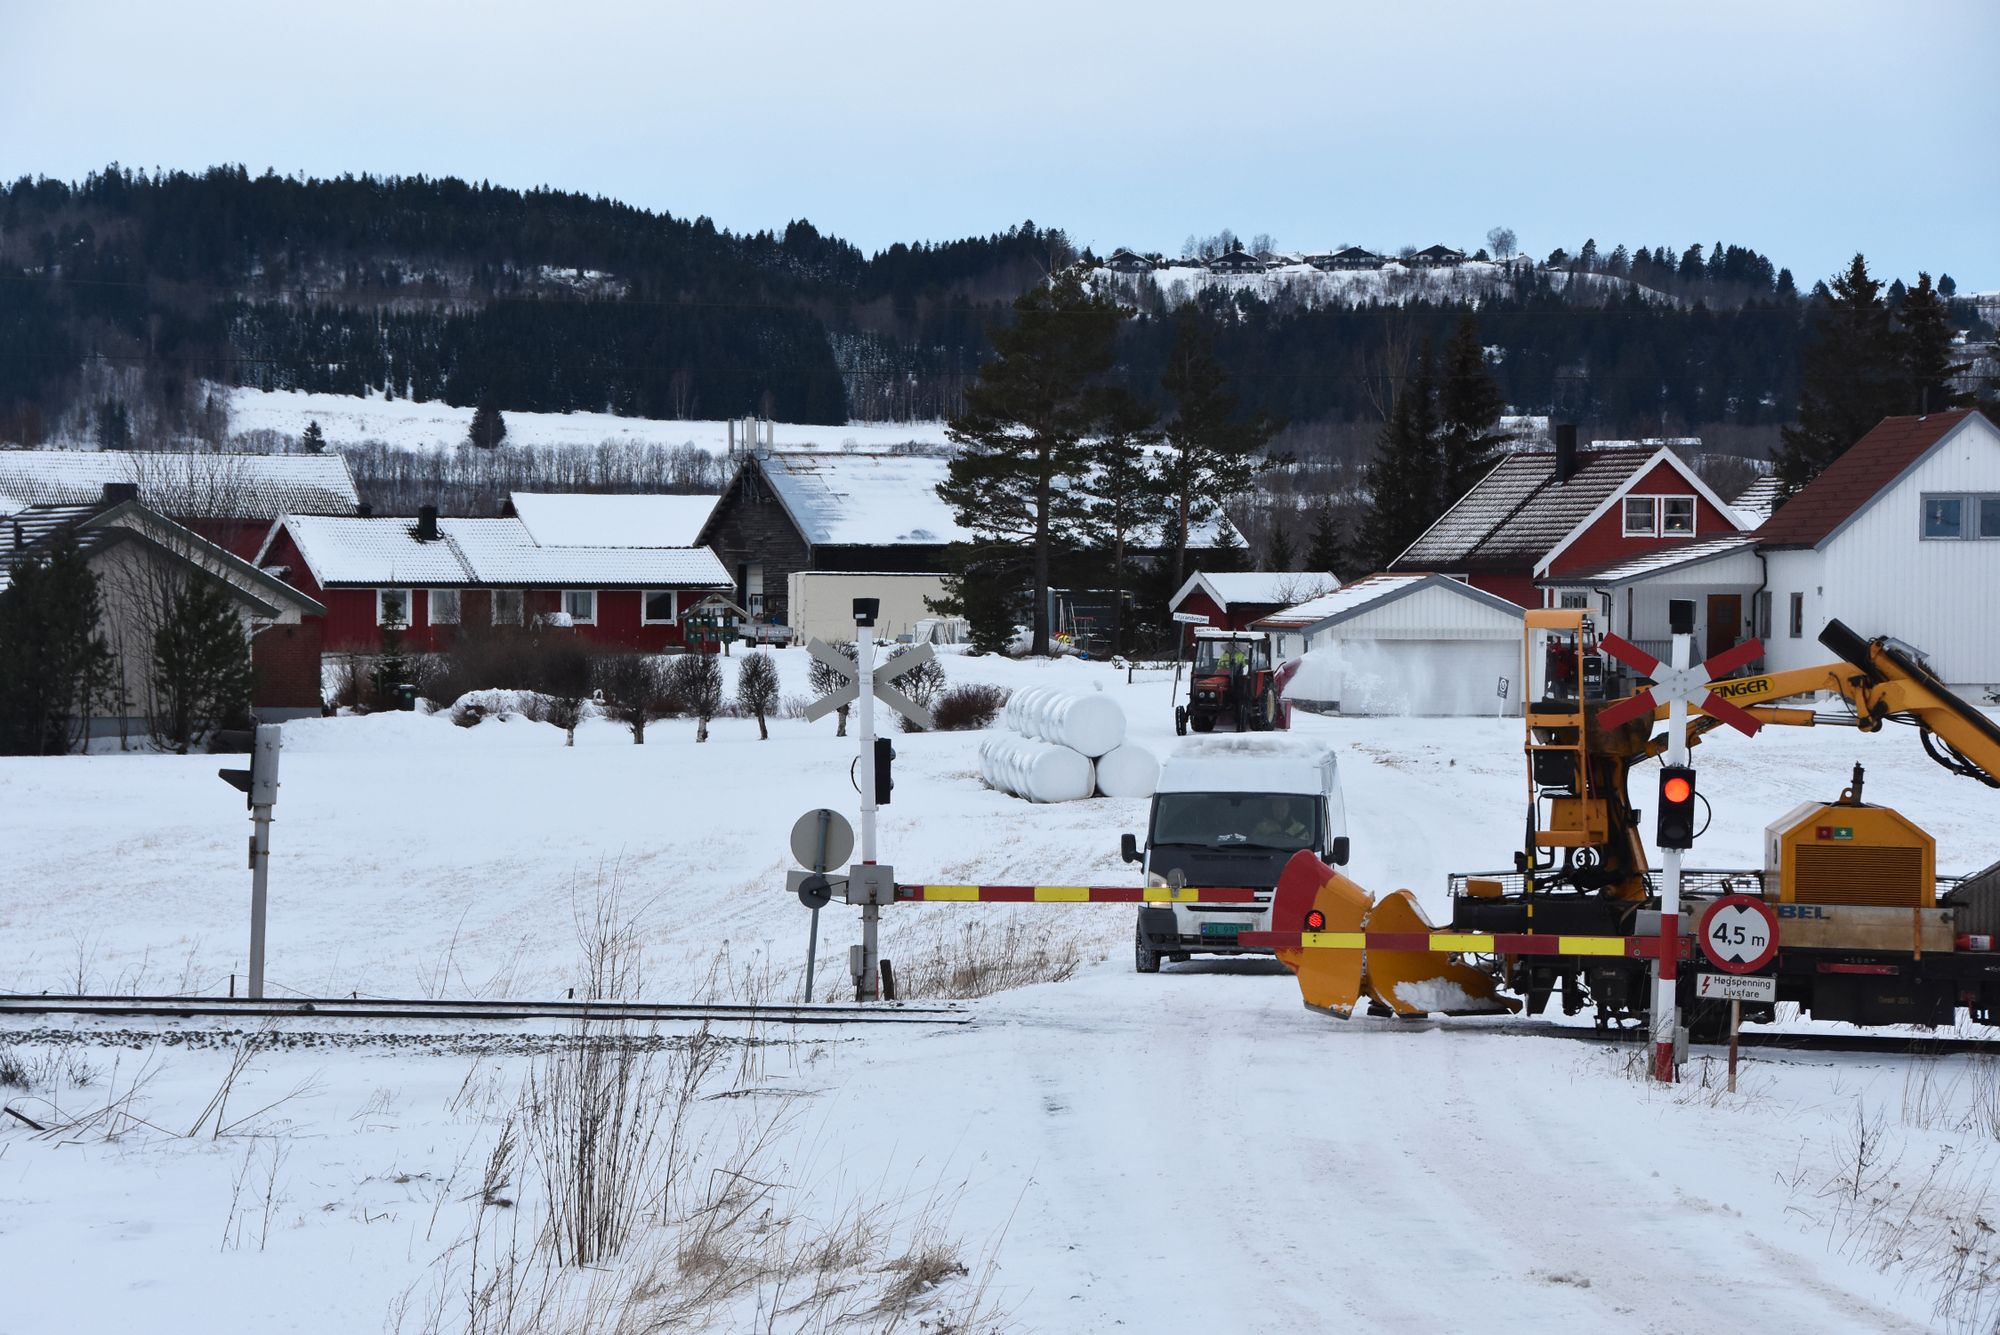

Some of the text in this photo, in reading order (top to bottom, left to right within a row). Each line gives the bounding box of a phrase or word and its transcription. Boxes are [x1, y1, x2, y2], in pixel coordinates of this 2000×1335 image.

[1712, 922, 1765, 947] 4,5 m
[1714, 976, 1771, 990] Høgspenning
[1724, 988, 1760, 998] Livsfare
